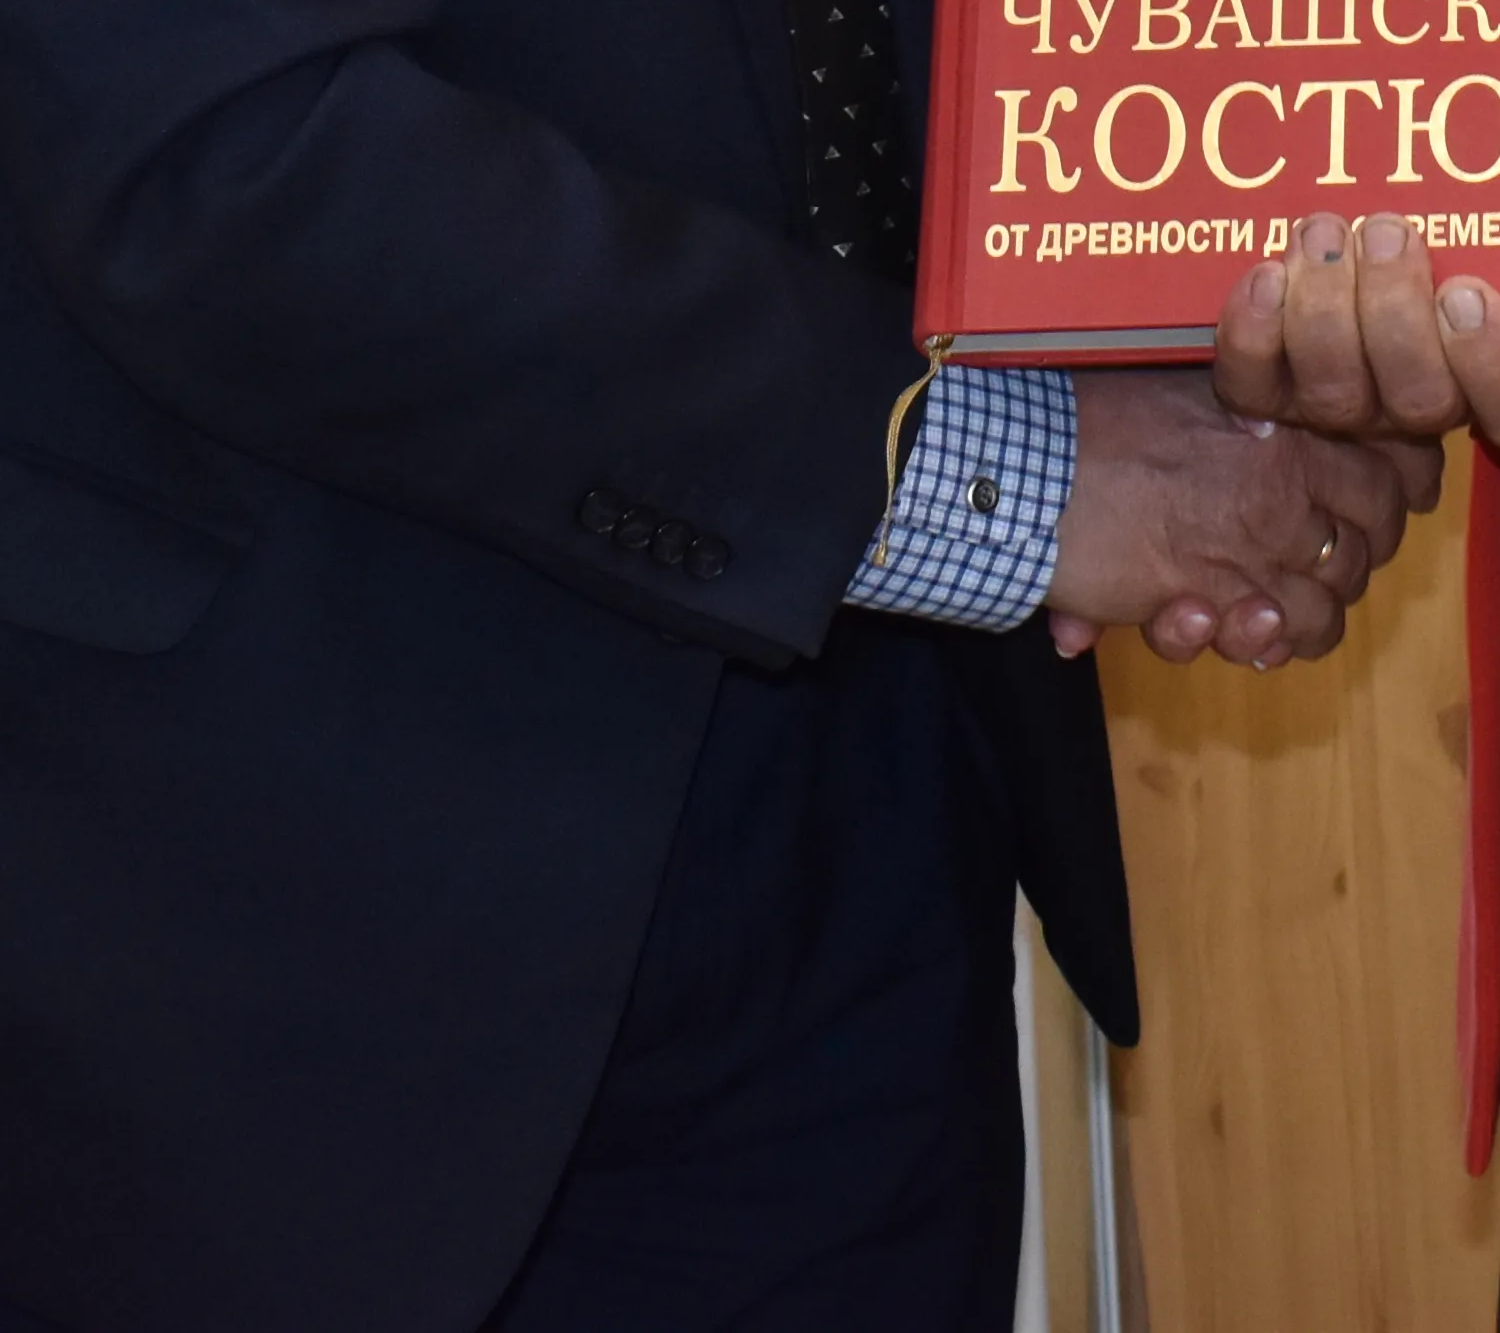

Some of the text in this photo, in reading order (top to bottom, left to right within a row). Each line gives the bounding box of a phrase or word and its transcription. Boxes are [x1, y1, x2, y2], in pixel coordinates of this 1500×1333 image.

[984, 223, 1028, 258] ОТ
[1036, 218, 1254, 263] ДРЕВНОСТИ
[1263, 217, 1303, 258] Д
